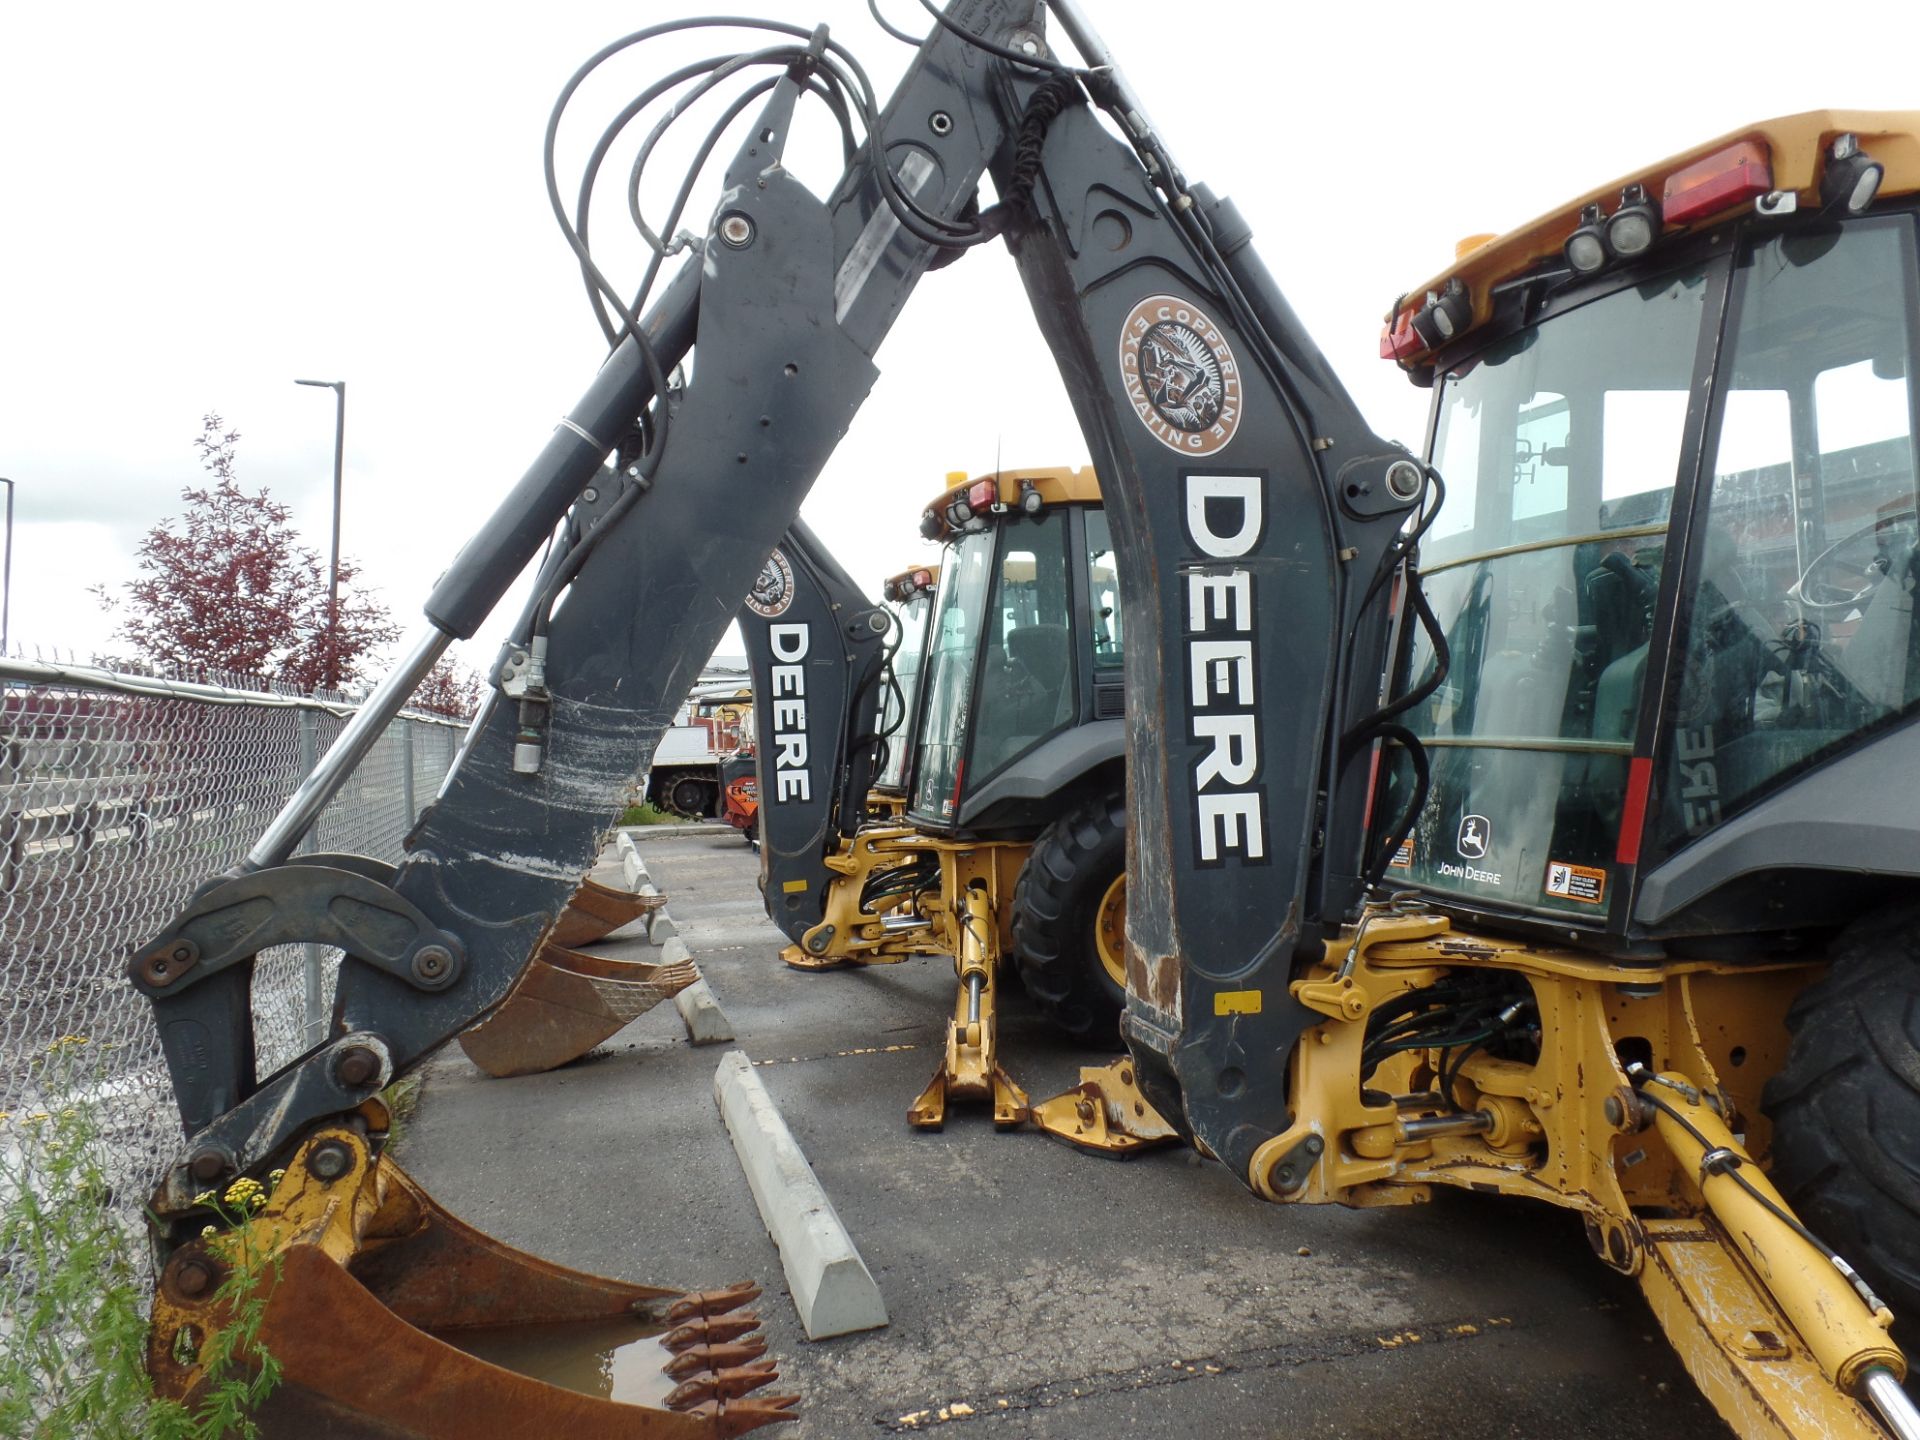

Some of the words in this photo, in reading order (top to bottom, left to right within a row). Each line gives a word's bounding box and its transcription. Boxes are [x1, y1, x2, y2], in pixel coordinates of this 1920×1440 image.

[1123, 316, 1203, 448] EXCAVATING
[1156, 306, 1238, 439] COPPERLINE
[769, 623, 810, 802] DEERE
[1186, 475, 1264, 861] DEERE
[1436, 861, 1464, 878] JOHN
[1464, 865, 1502, 885] DEERE
